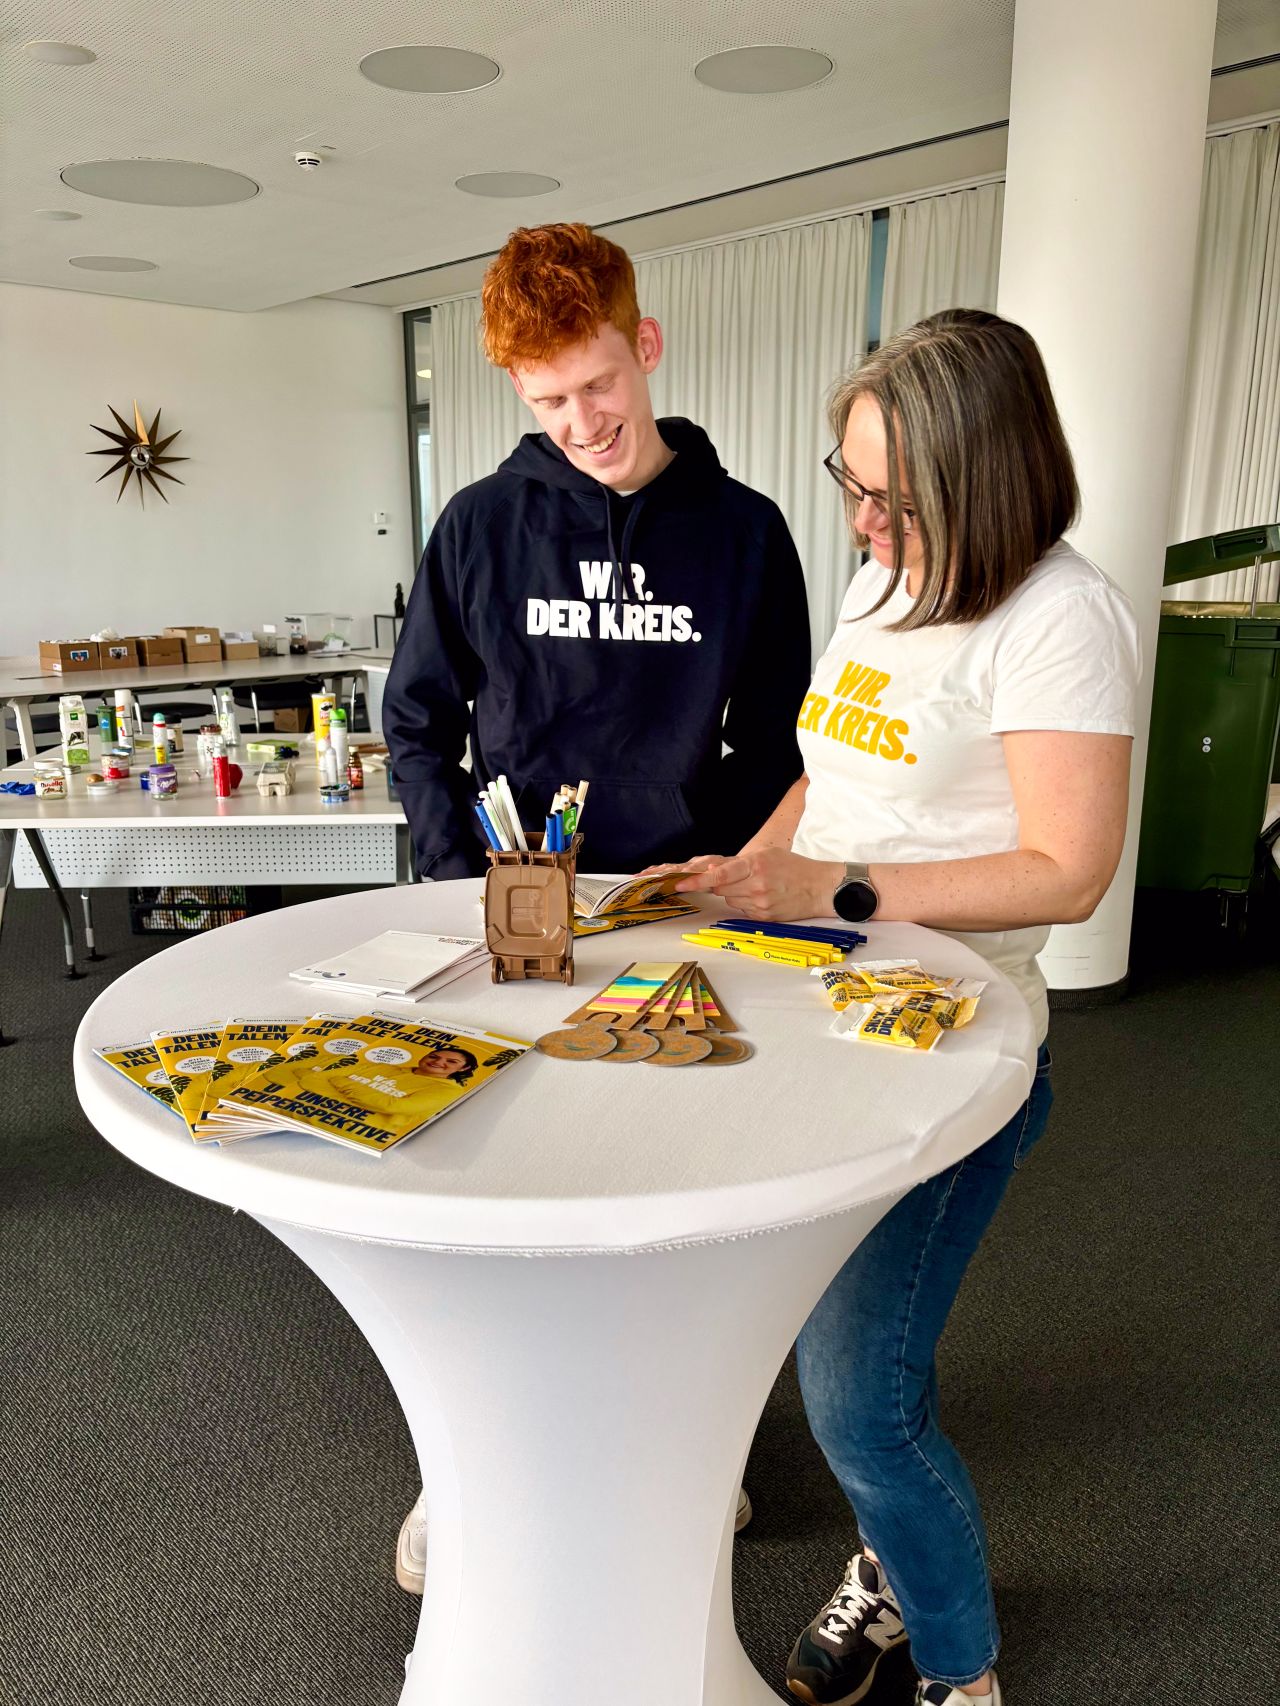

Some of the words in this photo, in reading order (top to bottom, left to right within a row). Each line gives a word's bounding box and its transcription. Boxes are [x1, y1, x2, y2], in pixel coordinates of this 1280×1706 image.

[527, 598, 591, 638] DER
[600, 602, 702, 642] KREIS.
[833, 660, 891, 708] WIR.
[797, 692, 830, 733] ER
[824, 701, 918, 765] KREIS.
[243, 1025, 287, 1033] DEIN
[320, 1020, 348, 1030] DE
[346, 1022, 393, 1038] TALE
[172, 1032, 219, 1045] DEIN
[414, 1027, 458, 1043] DEIN
[122, 1046, 158, 1059] DEI
[160, 1039, 222, 1055] TALEN
[295, 1090, 377, 1122] UNSERE
[258, 1095, 398, 1144] PERSPEKTIVE
